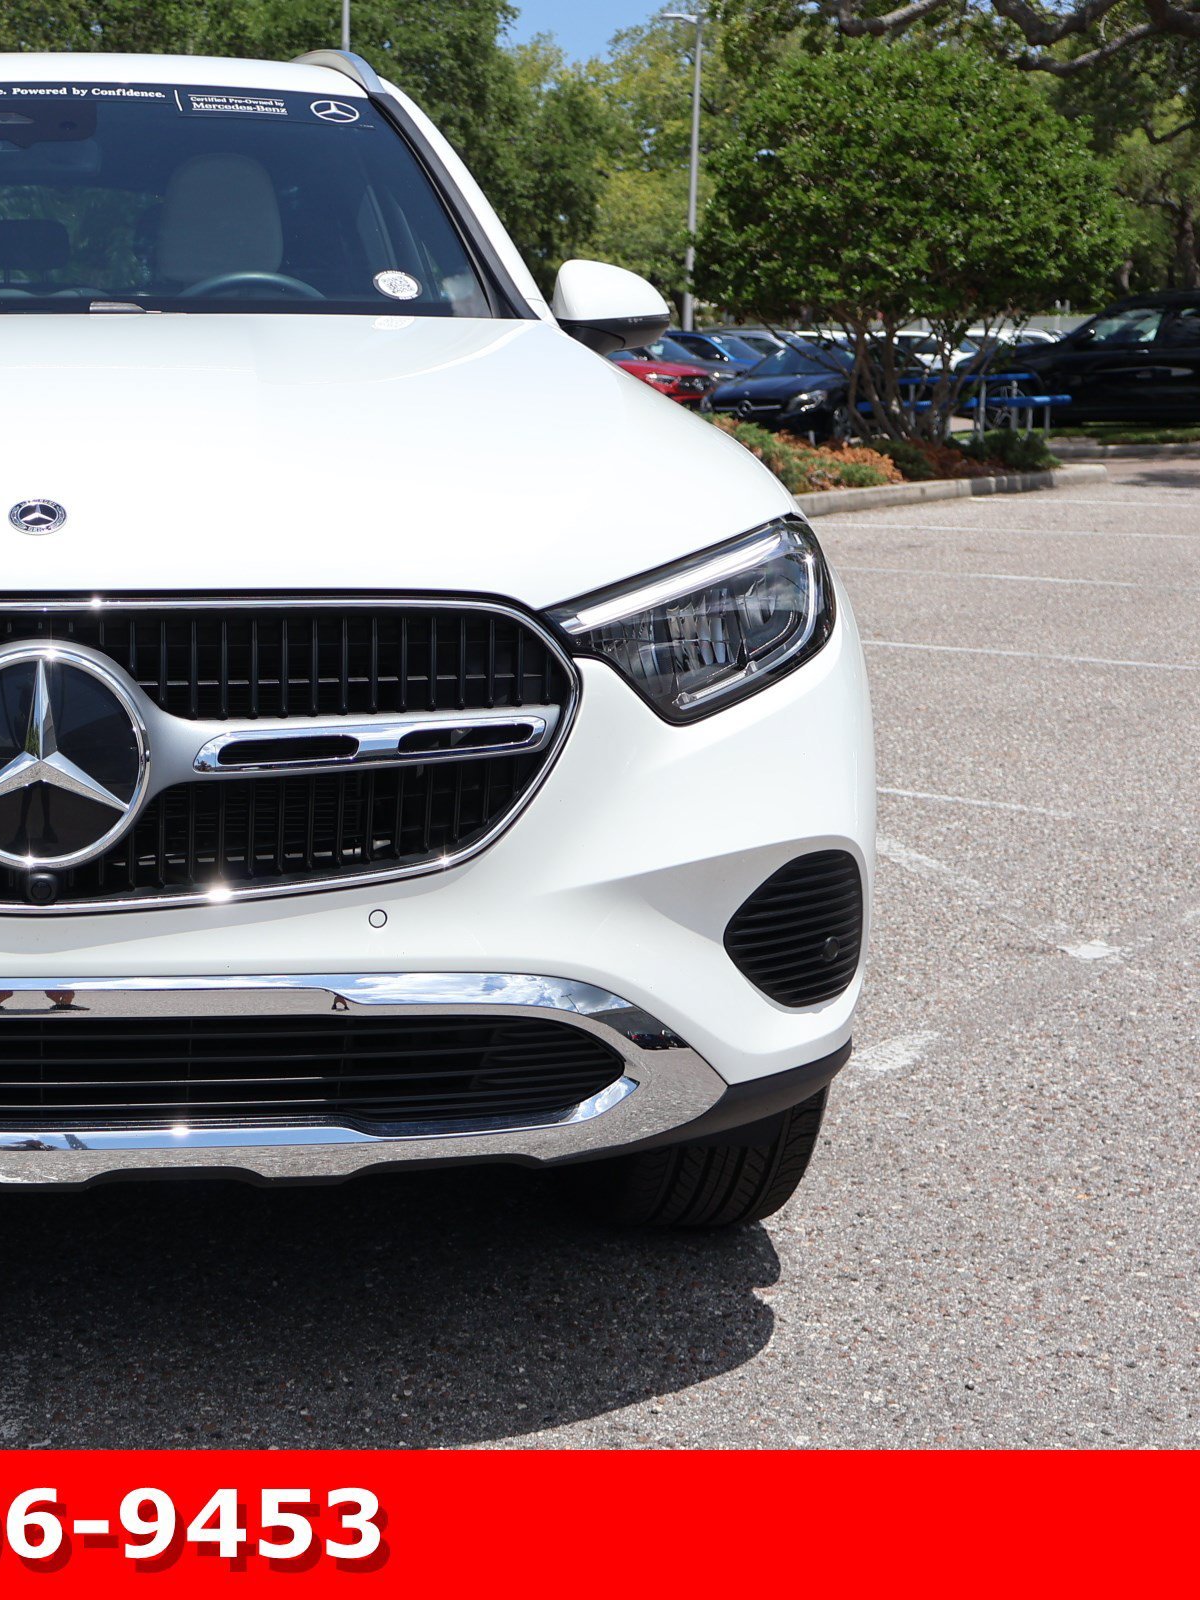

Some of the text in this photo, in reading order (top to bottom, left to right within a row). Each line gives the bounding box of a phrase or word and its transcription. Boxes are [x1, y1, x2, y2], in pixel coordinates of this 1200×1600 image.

[12, 87, 67, 95] Powered
[72, 87, 88, 96] by
[91, 87, 166, 98] Confidence.
[190, 96, 227, 104] Certified
[229, 98, 273, 106] Pre-Owned
[192, 102, 288, 113] Mercedes-Benz
